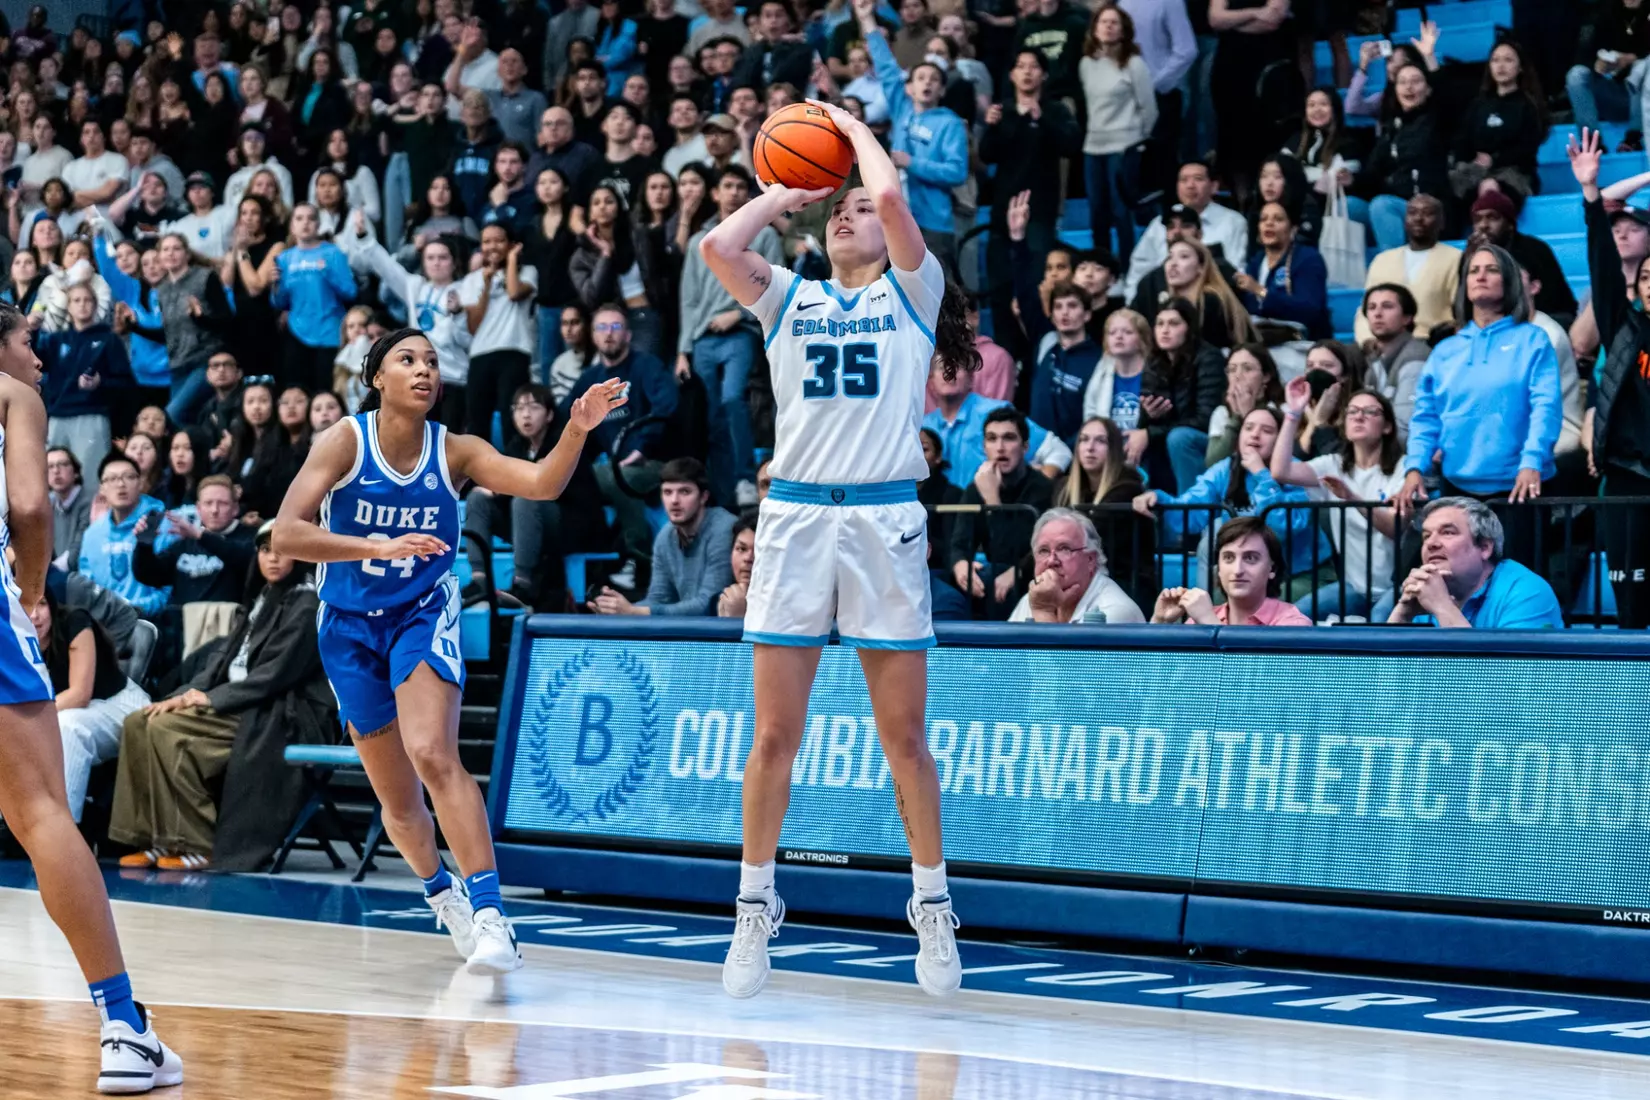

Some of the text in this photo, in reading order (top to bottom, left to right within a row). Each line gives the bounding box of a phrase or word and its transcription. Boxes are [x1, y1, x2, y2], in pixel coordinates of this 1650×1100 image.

[792, 314, 896, 337] COLUMBIA
[803, 342, 880, 400] 35
[354, 498, 440, 530] DUKE
[574, 694, 615, 767] B
[669, 709, 1650, 831] COLMBI BARNARD ATHLETIC CONS
[785, 850, 849, 864] DAKTRONICS
[1603, 910, 1650, 923] DAKTR
